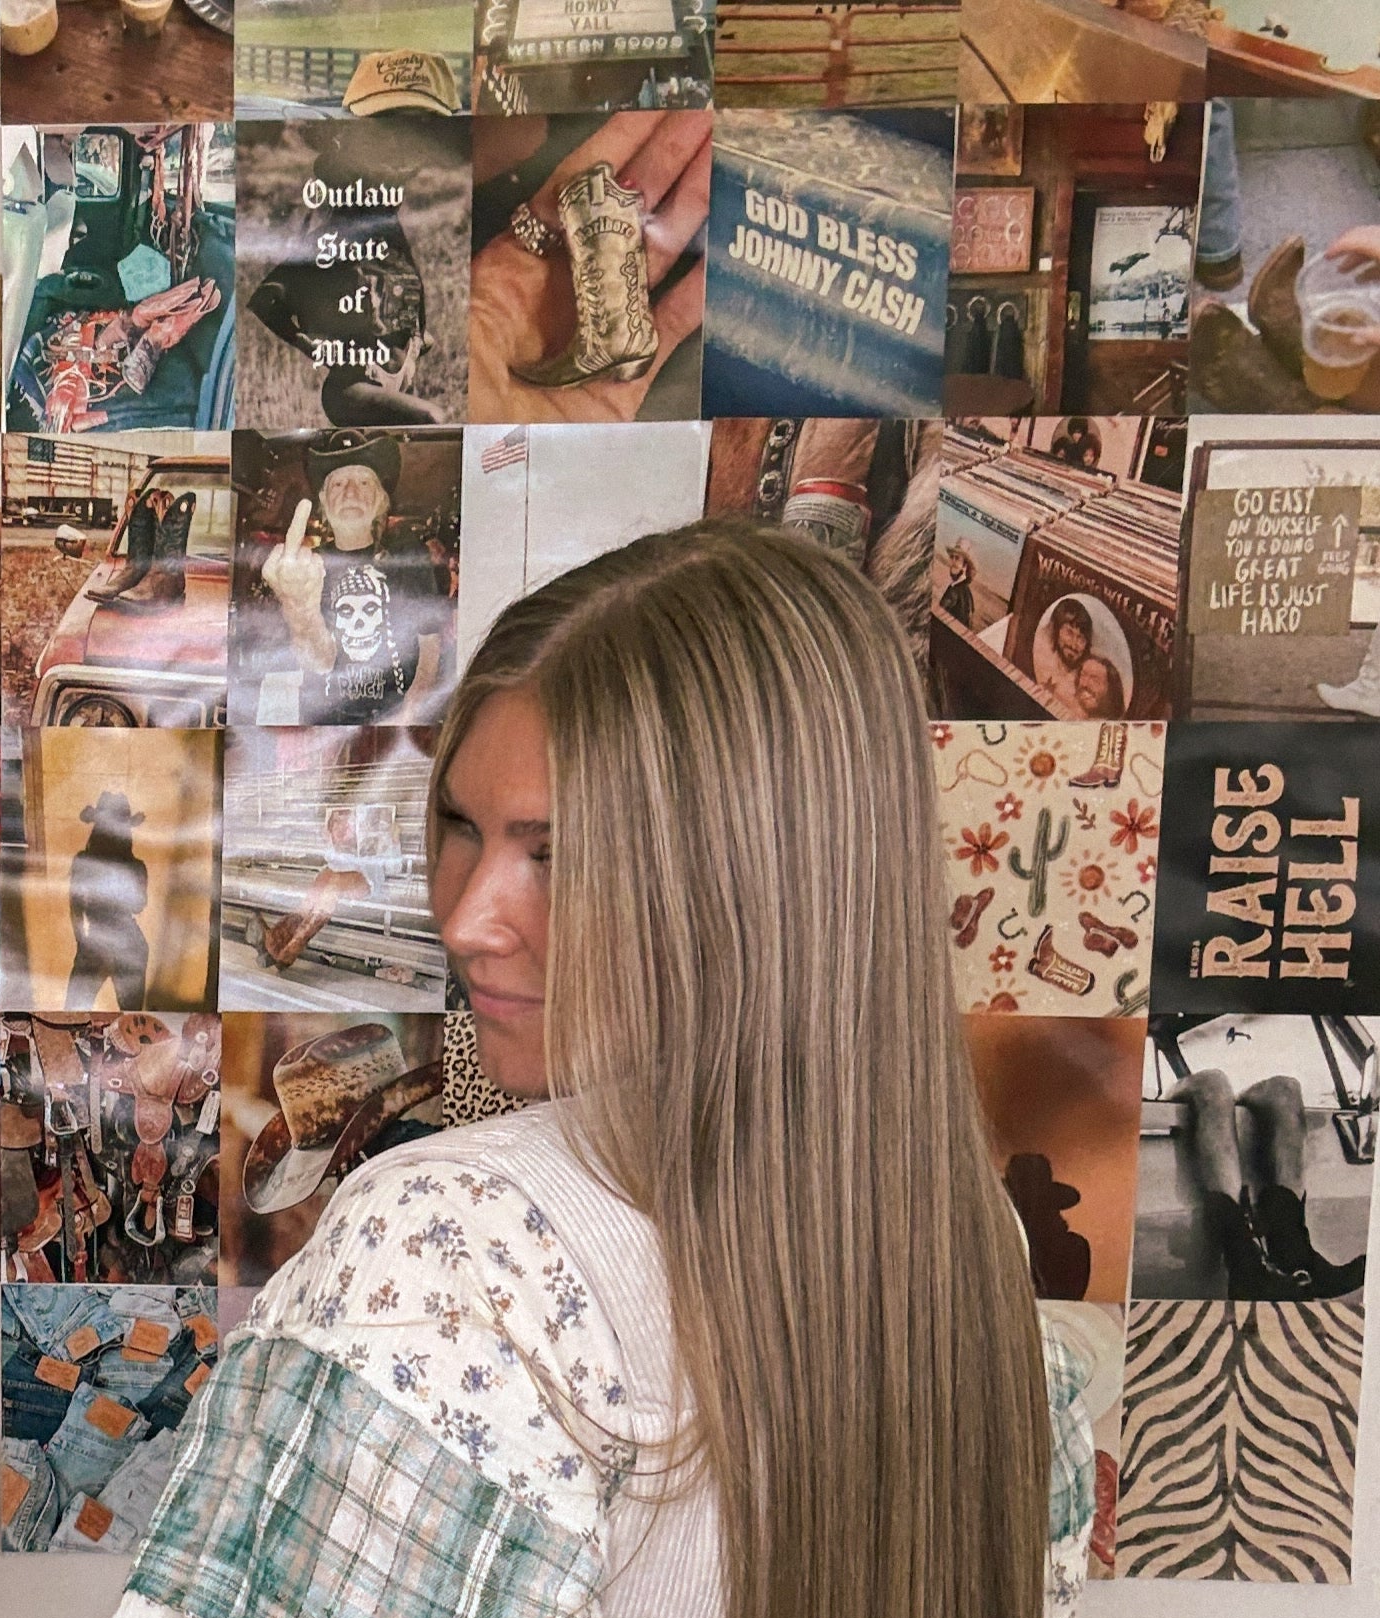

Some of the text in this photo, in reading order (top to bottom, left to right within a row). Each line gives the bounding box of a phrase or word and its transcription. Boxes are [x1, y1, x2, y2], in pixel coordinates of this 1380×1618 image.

[564, 0, 619, 13] HOWDY
[570, 16, 613, 32] YALL
[508, 36, 683, 57] WESTERN GOODS
[303, 178, 404, 210] Outlaw
[745, 188, 918, 281] GOD BLESS
[316, 231, 389, 269] State
[729, 225, 925, 335] JOHNNY CASH
[338, 285, 369, 314] of
[312, 339, 390, 369] Mind
[1234, 487, 1315, 517] GO EASY
[1227, 514, 1322, 537] ON YOURSELF
[1271, 538, 1315, 554] DOING
[1235, 557, 1302, 583] GREAT
[1210, 581, 1329, 609] LIFE IS JUST
[1240, 606, 1301, 636] HARD
[1202, 763, 1285, 979] RAISE
[1279, 796, 1360, 980] HELL
